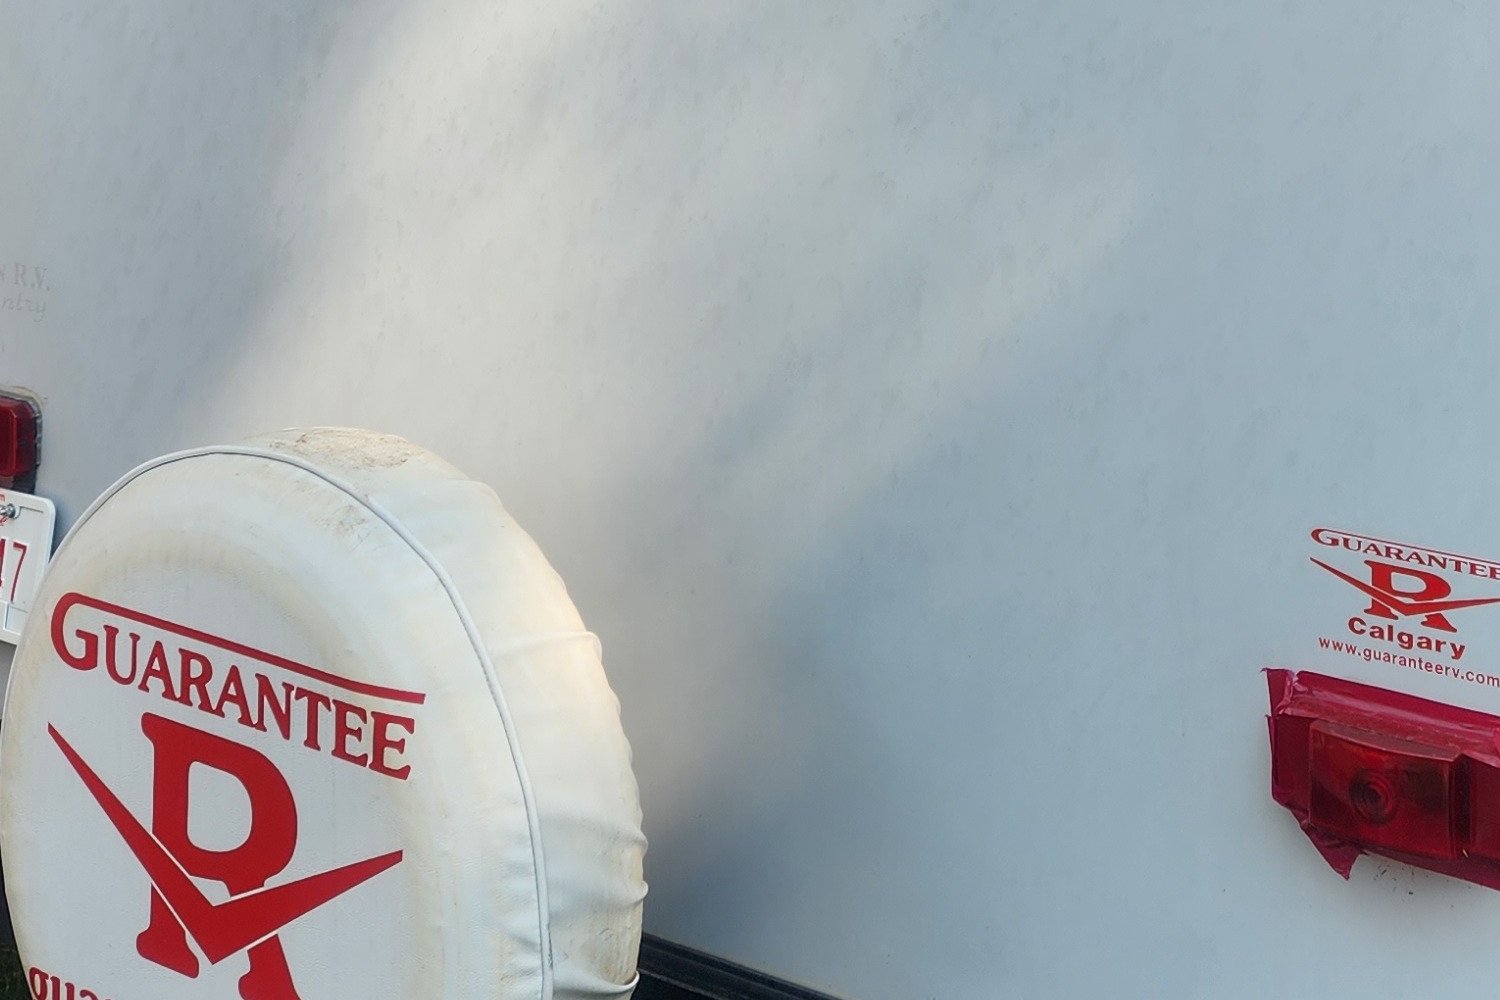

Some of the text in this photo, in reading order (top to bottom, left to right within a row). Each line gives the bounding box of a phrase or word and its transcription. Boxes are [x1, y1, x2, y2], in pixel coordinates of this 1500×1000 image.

[1318, 637, 1500, 688] www.guaranteerv.com
[1348, 617, 1465, 660] Calgary
[51, 592, 416, 780] GUARANTEE
